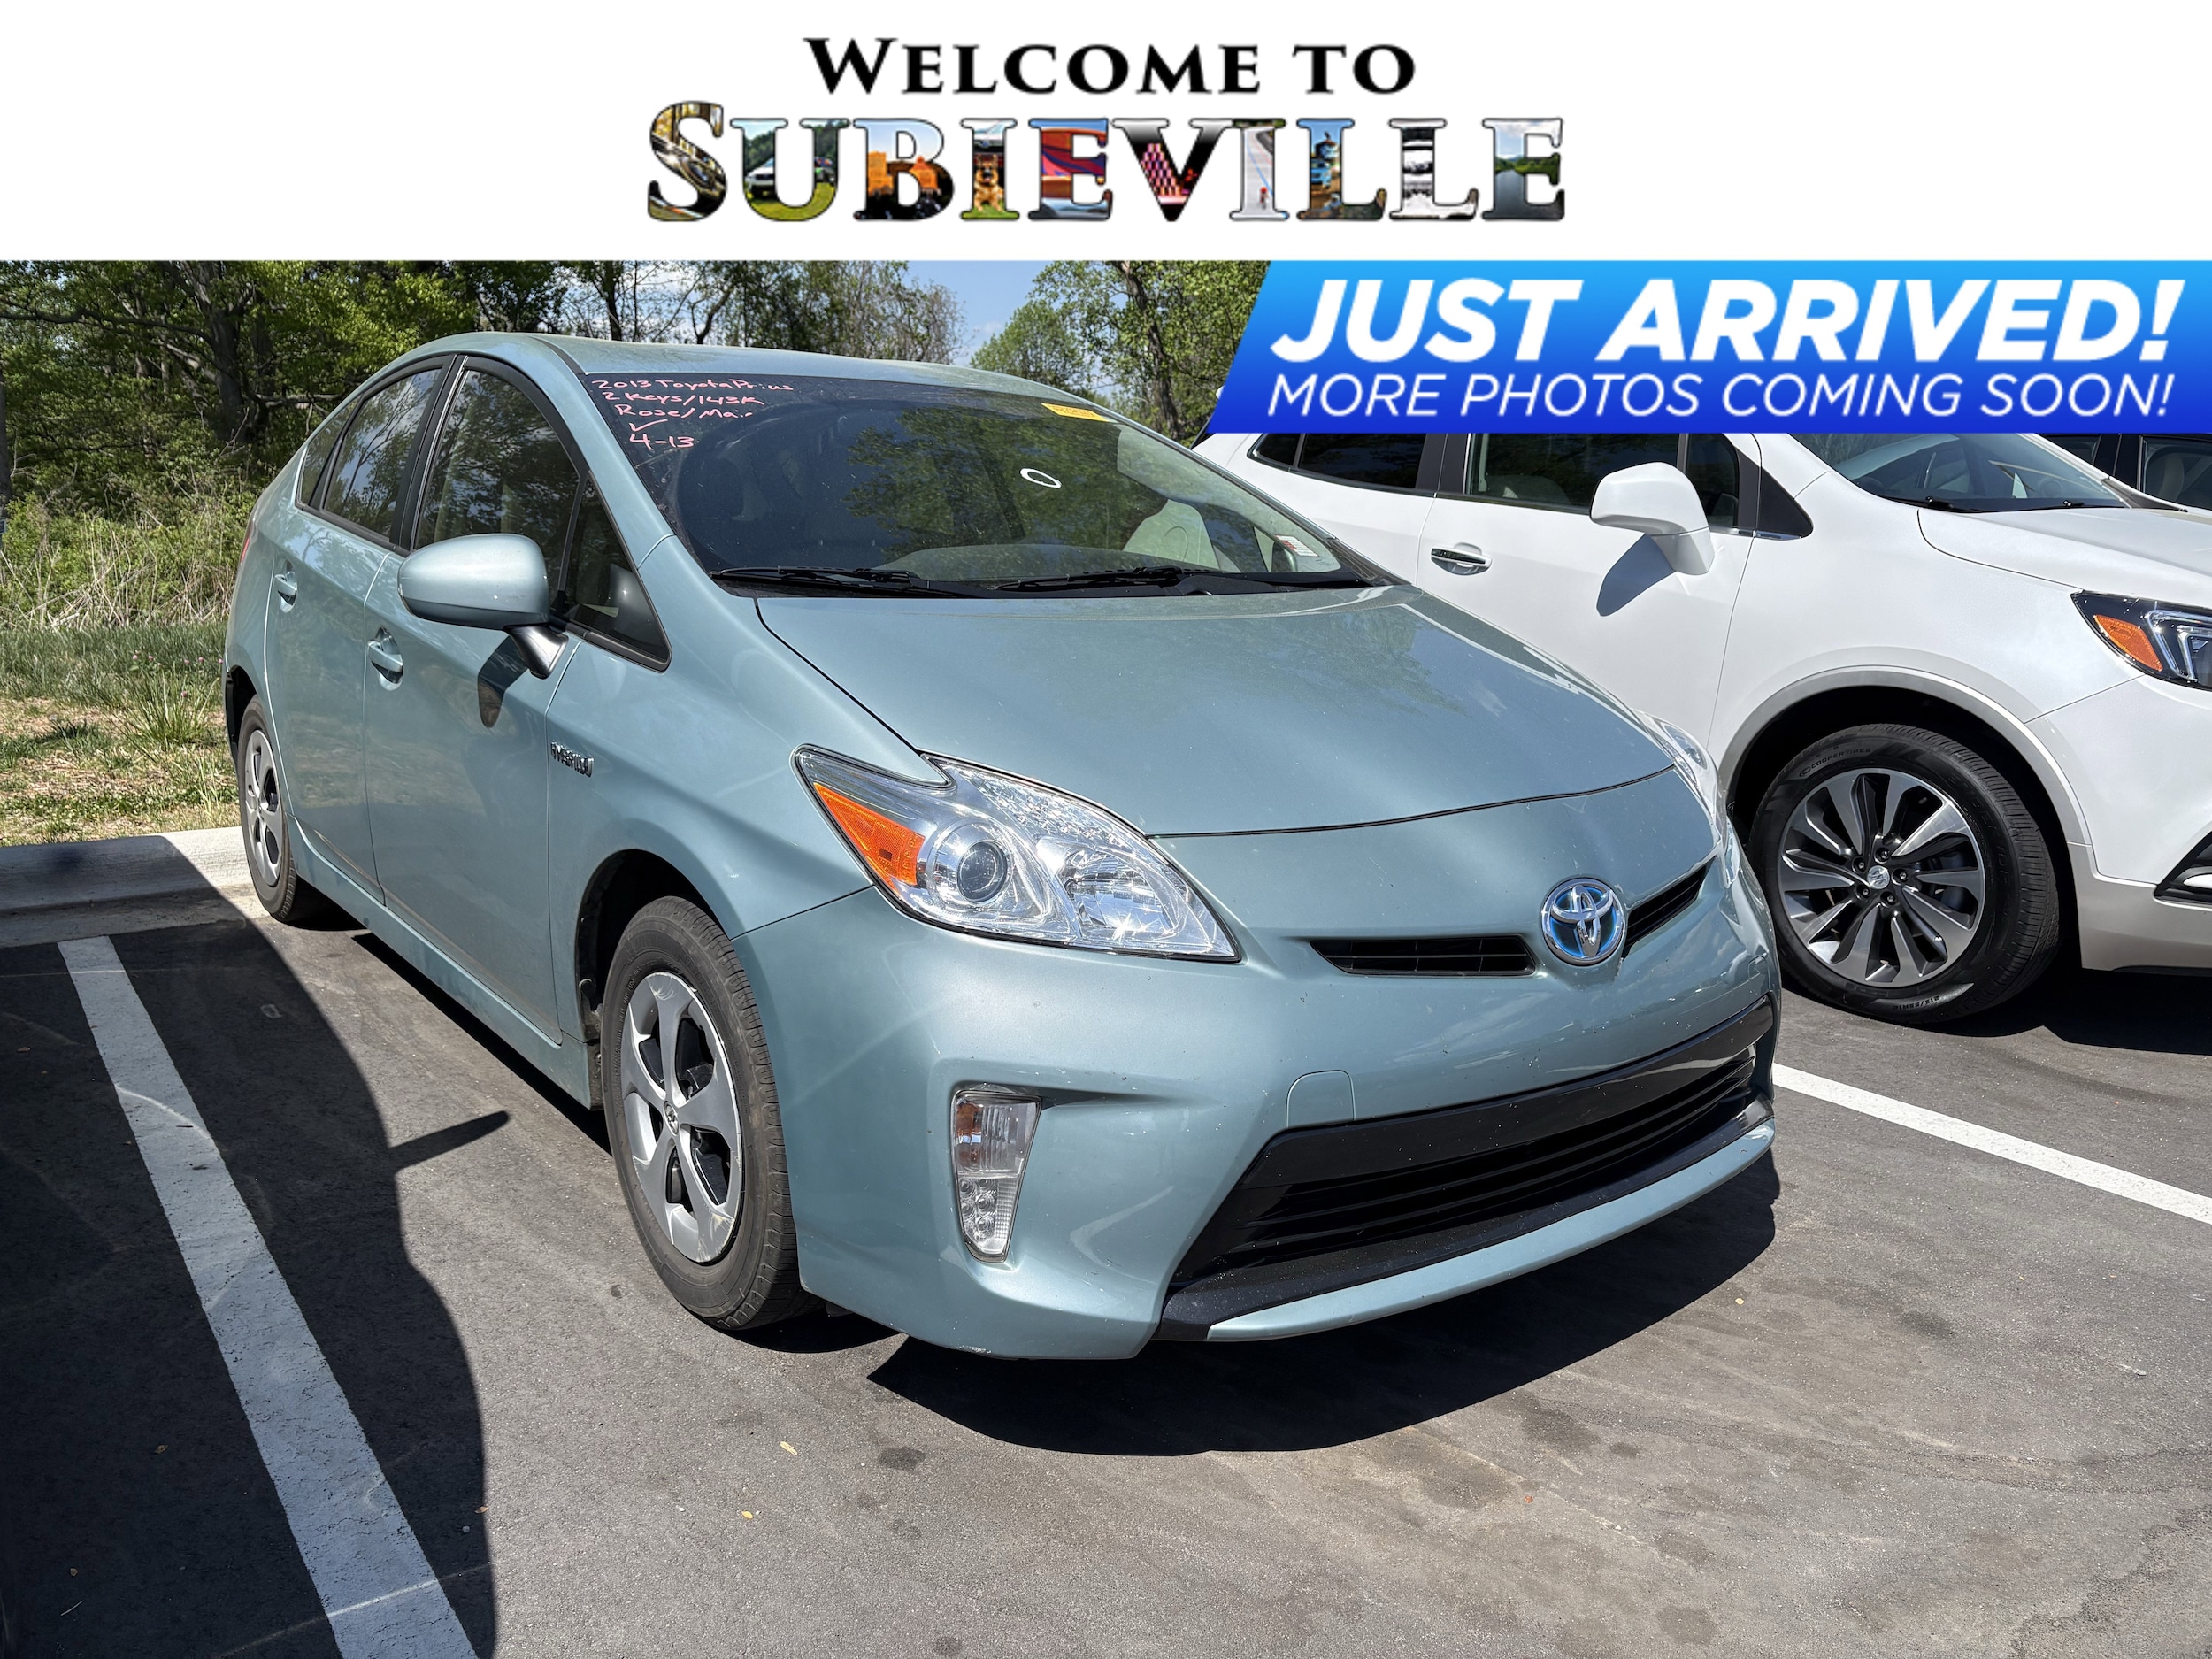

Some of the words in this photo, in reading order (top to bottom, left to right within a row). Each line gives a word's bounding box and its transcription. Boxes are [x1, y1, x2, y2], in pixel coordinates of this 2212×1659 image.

[591, 380, 652, 389] 2013
[655, 379, 734, 391] Toyota
[602, 391, 620, 400] 2
[629, 433, 695, 451] 4-13
